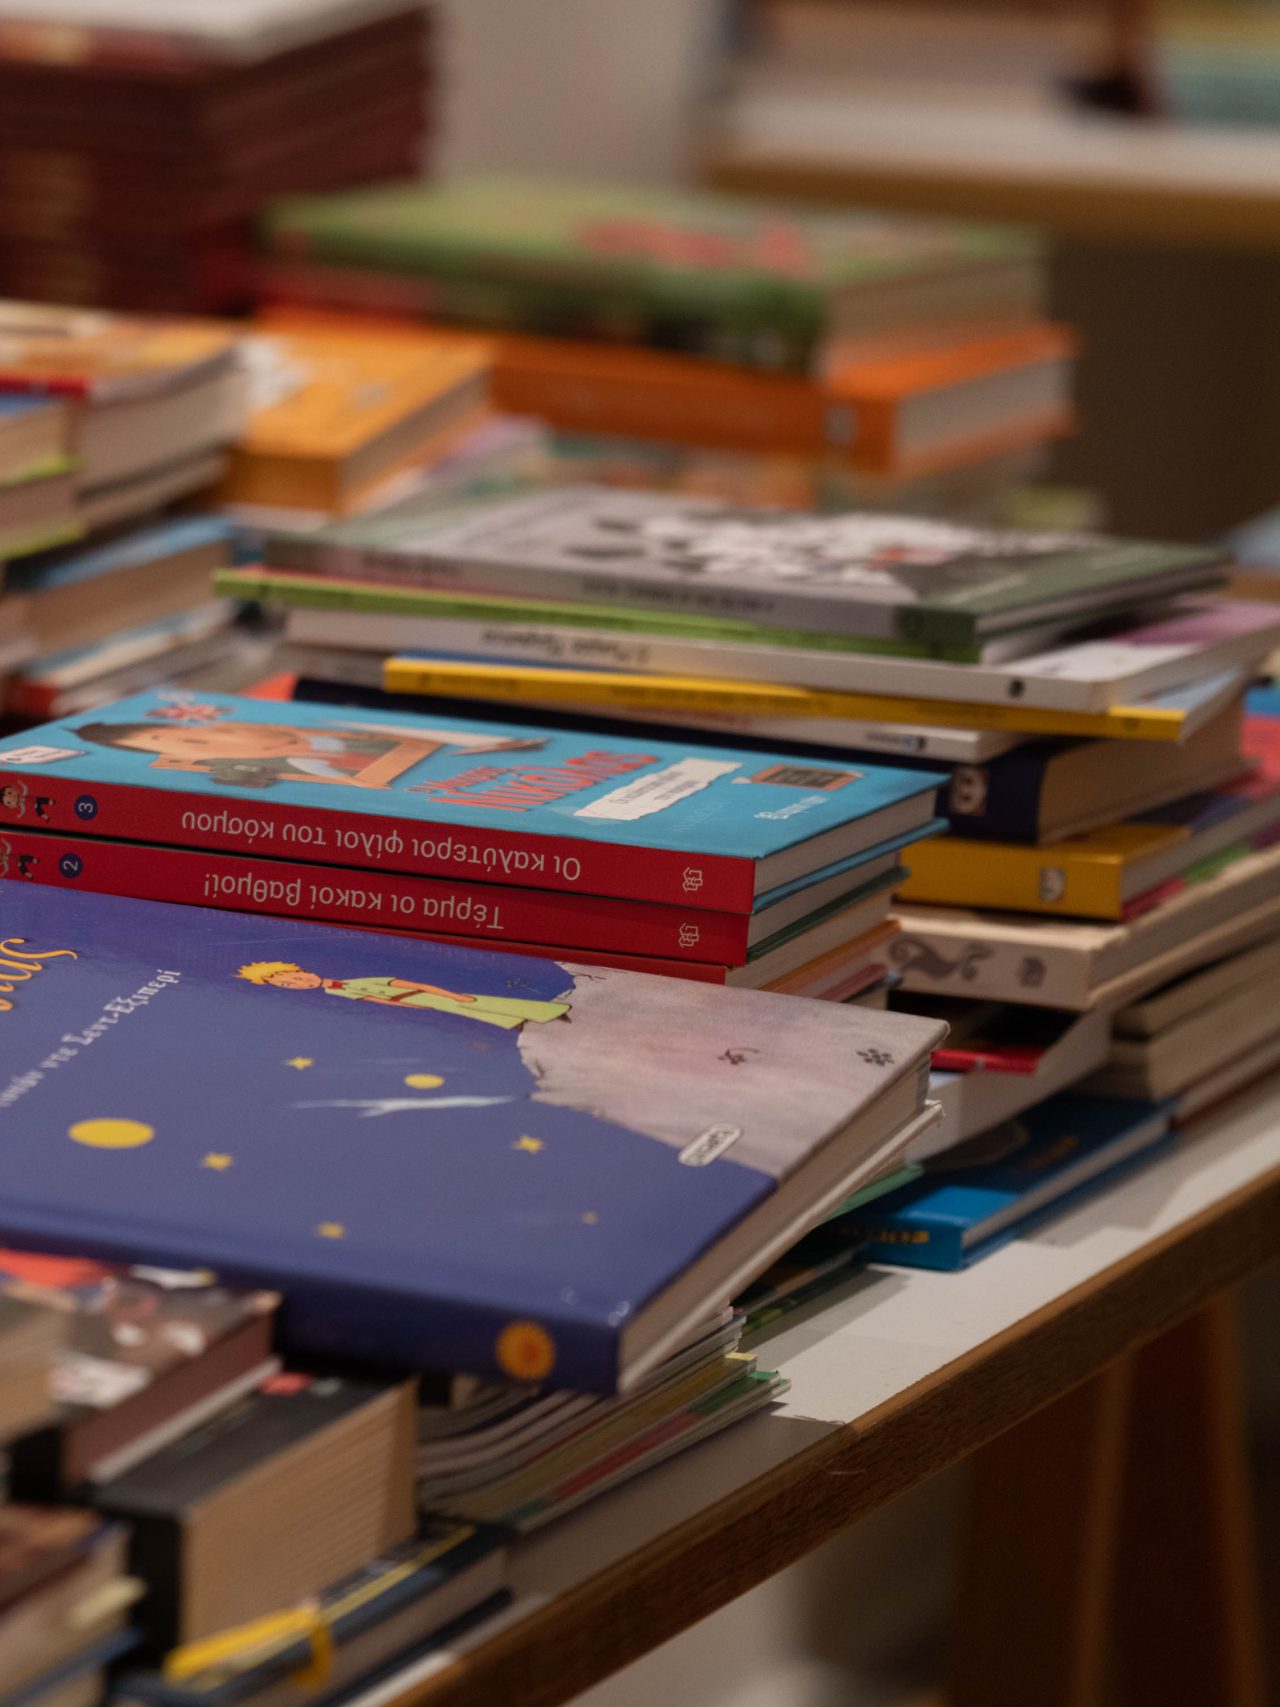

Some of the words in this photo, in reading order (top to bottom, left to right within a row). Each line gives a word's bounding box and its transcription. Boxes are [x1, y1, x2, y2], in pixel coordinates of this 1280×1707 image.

[78, 802, 94, 813] 3
[182, 810, 275, 845] κόσμου
[282, 823, 327, 846] του
[335, 829, 404, 858] φίλοι
[412, 837, 546, 874] καλύτεροι
[63, 860, 79, 871] 2
[554, 855, 582, 881] Οι
[203, 872, 302, 907] βαθμοί!
[309, 884, 383, 912] κακοί
[390, 895, 417, 914] οι
[422, 896, 506, 930] Τέρμα
[39, 1047, 79, 1069] ντε
[60, 967, 183, 1047] Σεντ-Εξιπερί
